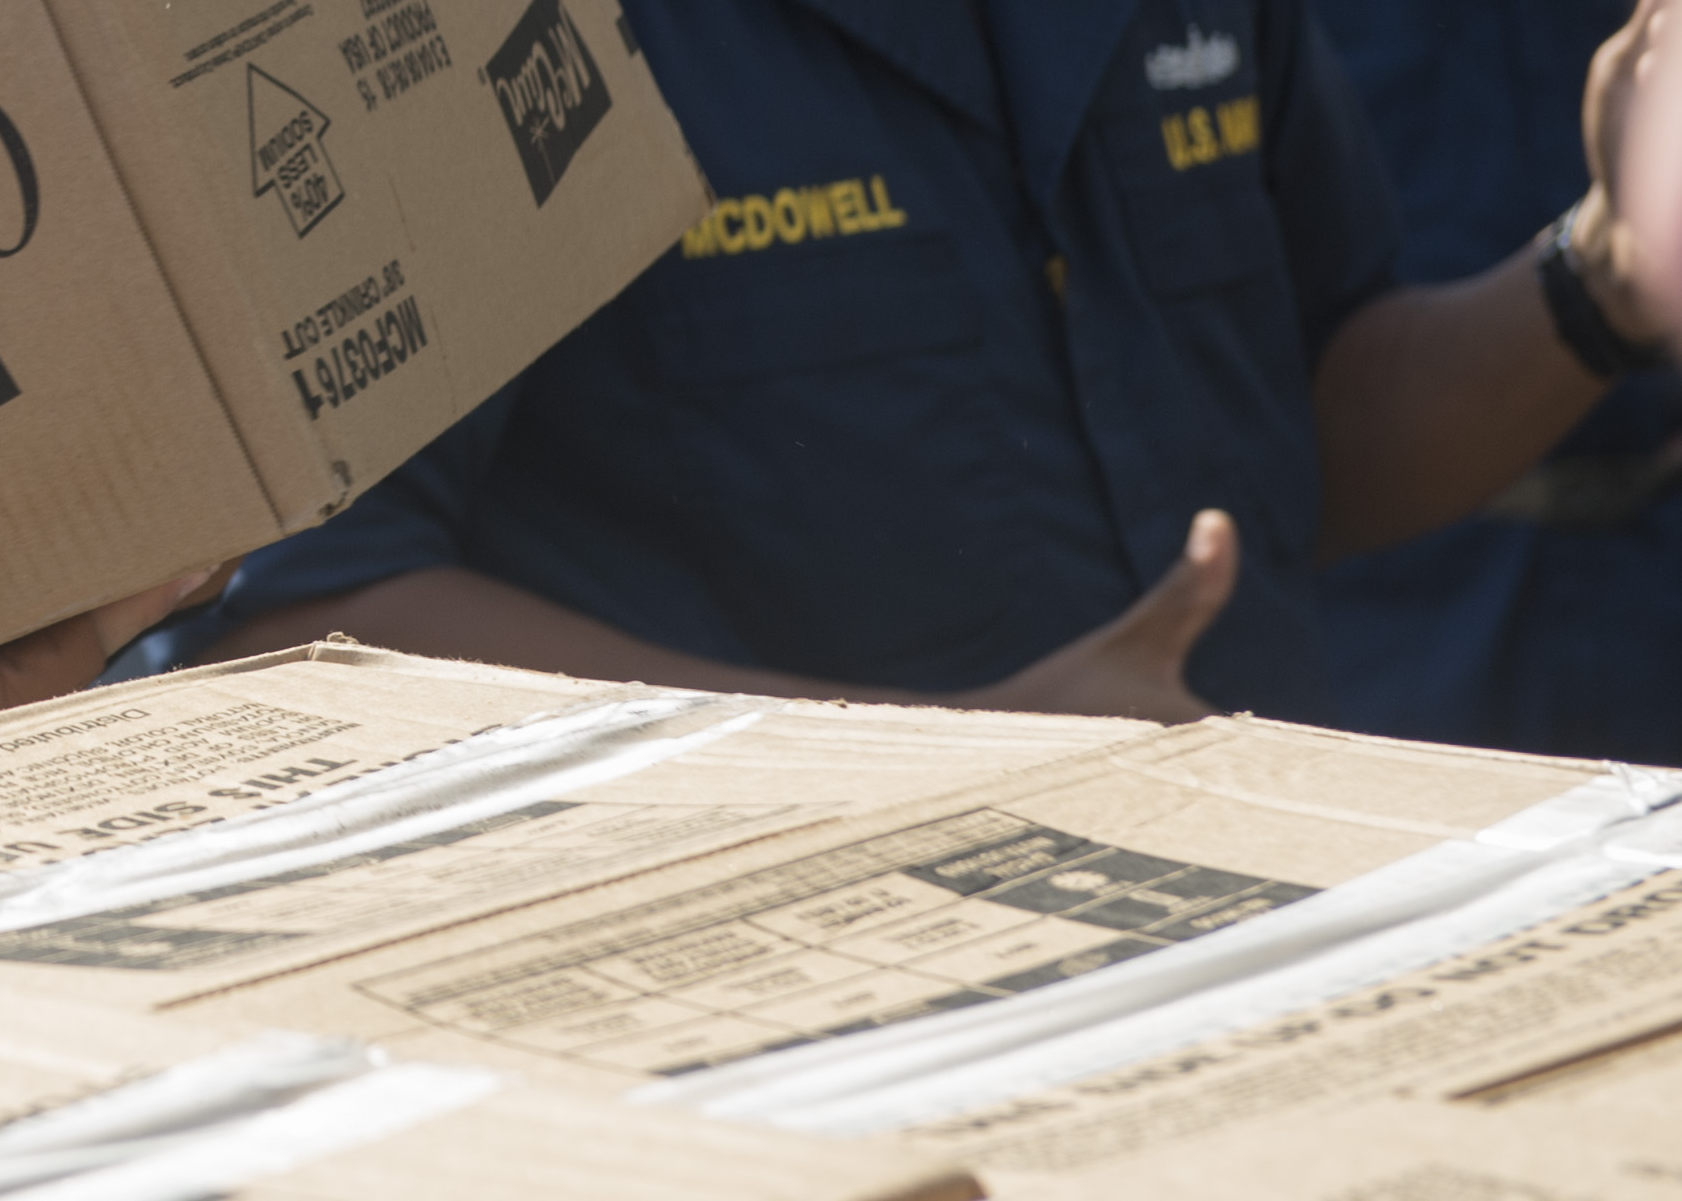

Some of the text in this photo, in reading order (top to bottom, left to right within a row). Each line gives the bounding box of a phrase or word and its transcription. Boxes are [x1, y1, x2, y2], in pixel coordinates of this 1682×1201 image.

[255, 106, 315, 174] SODIUM
[275, 139, 319, 192] LESS
[289, 292, 432, 427] MCF03761
[205, 756, 357, 799] THIS
[55, 801, 209, 840] SIDE
